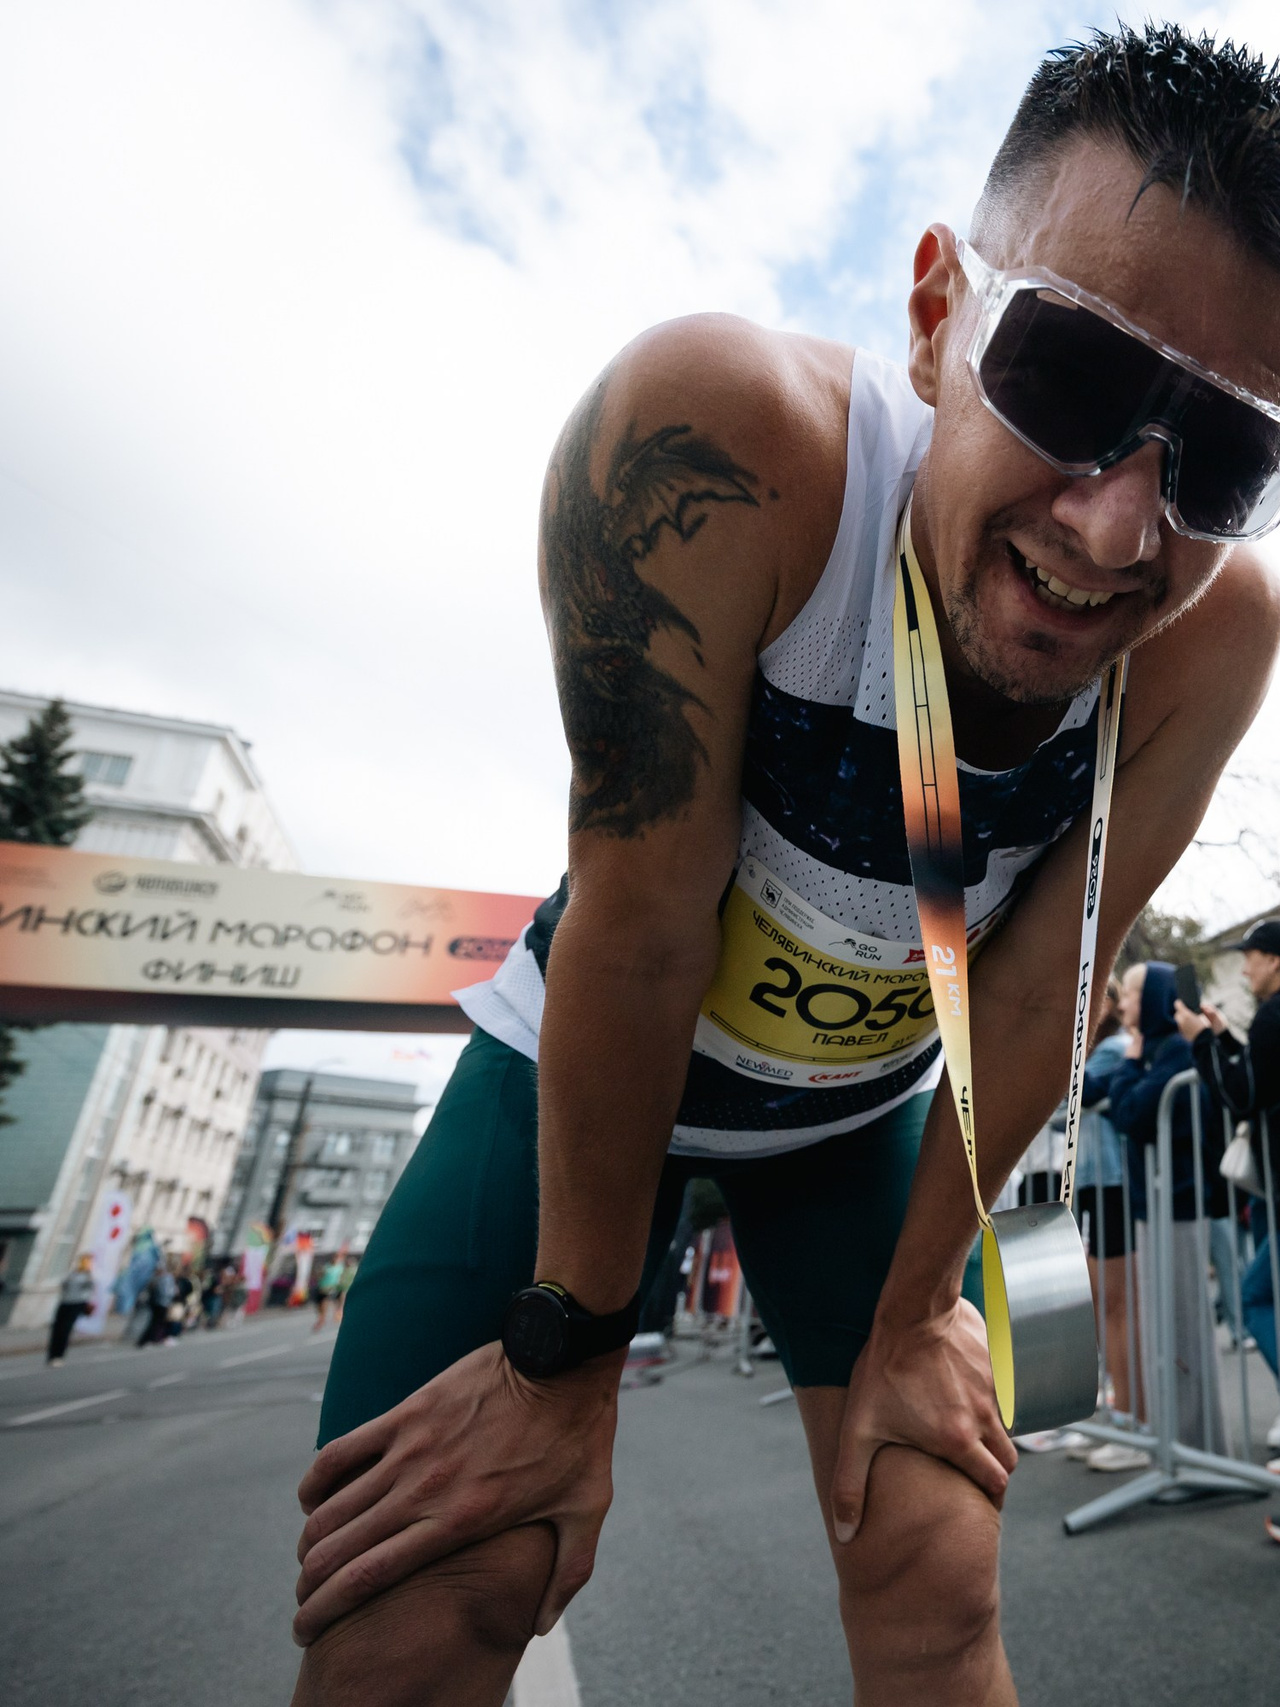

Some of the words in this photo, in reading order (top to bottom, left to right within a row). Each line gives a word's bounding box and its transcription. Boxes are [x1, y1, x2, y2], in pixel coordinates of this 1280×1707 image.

[1088, 854, 1099, 909] 2026
[752, 909, 870, 983] ЧЕЛЯБИНСКИЙ
[873, 972, 930, 984] МАРА
[855, 950, 882, 961] RUN
[858, 943, 878, 953] GO
[931, 945, 957, 976] 21
[811, 1032, 889, 1047] ПАВЕЛ
